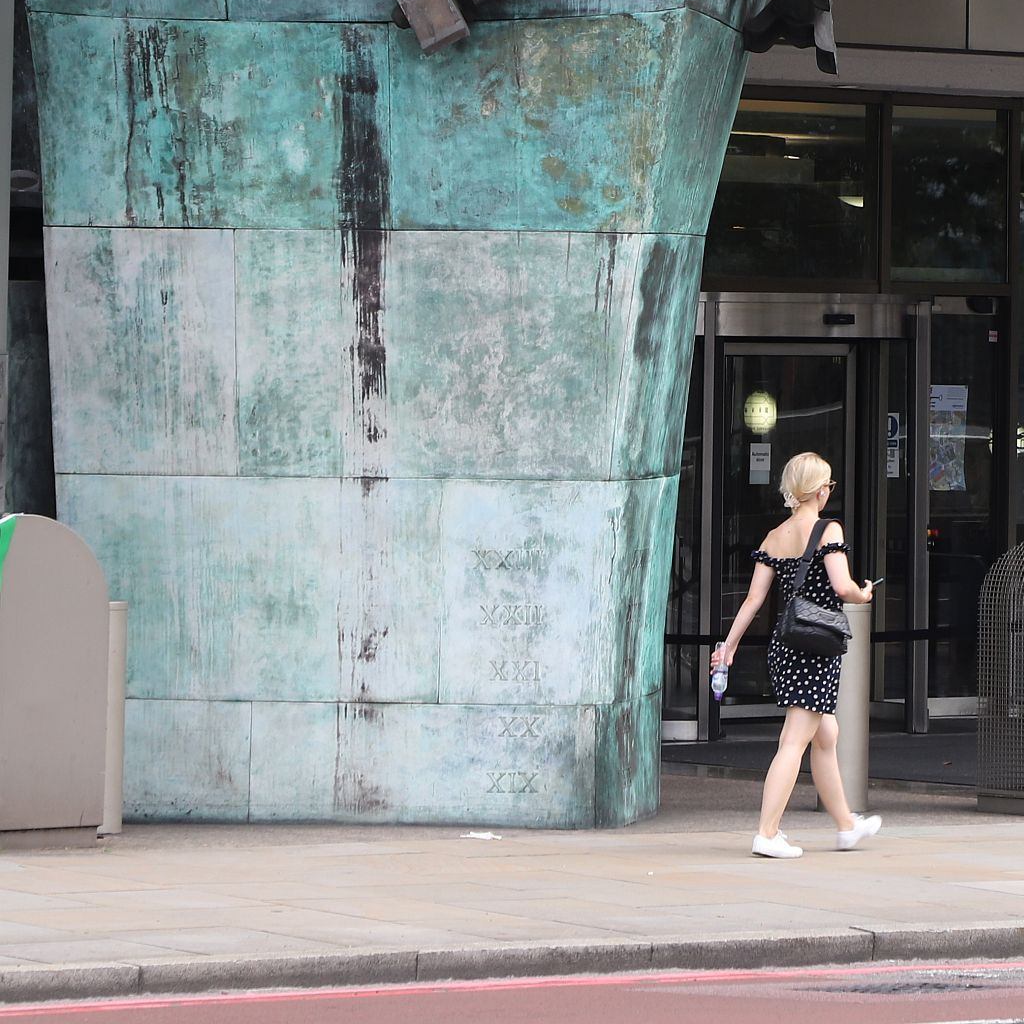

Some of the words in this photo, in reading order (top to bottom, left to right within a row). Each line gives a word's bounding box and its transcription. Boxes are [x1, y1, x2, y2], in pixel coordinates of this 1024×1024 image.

[471, 548, 544, 571] XXIII
[479, 603, 543, 626] XXII
[489, 659, 541, 682] XXI
[498, 716, 540, 738] XX
[486, 771, 539, 794] XIX
